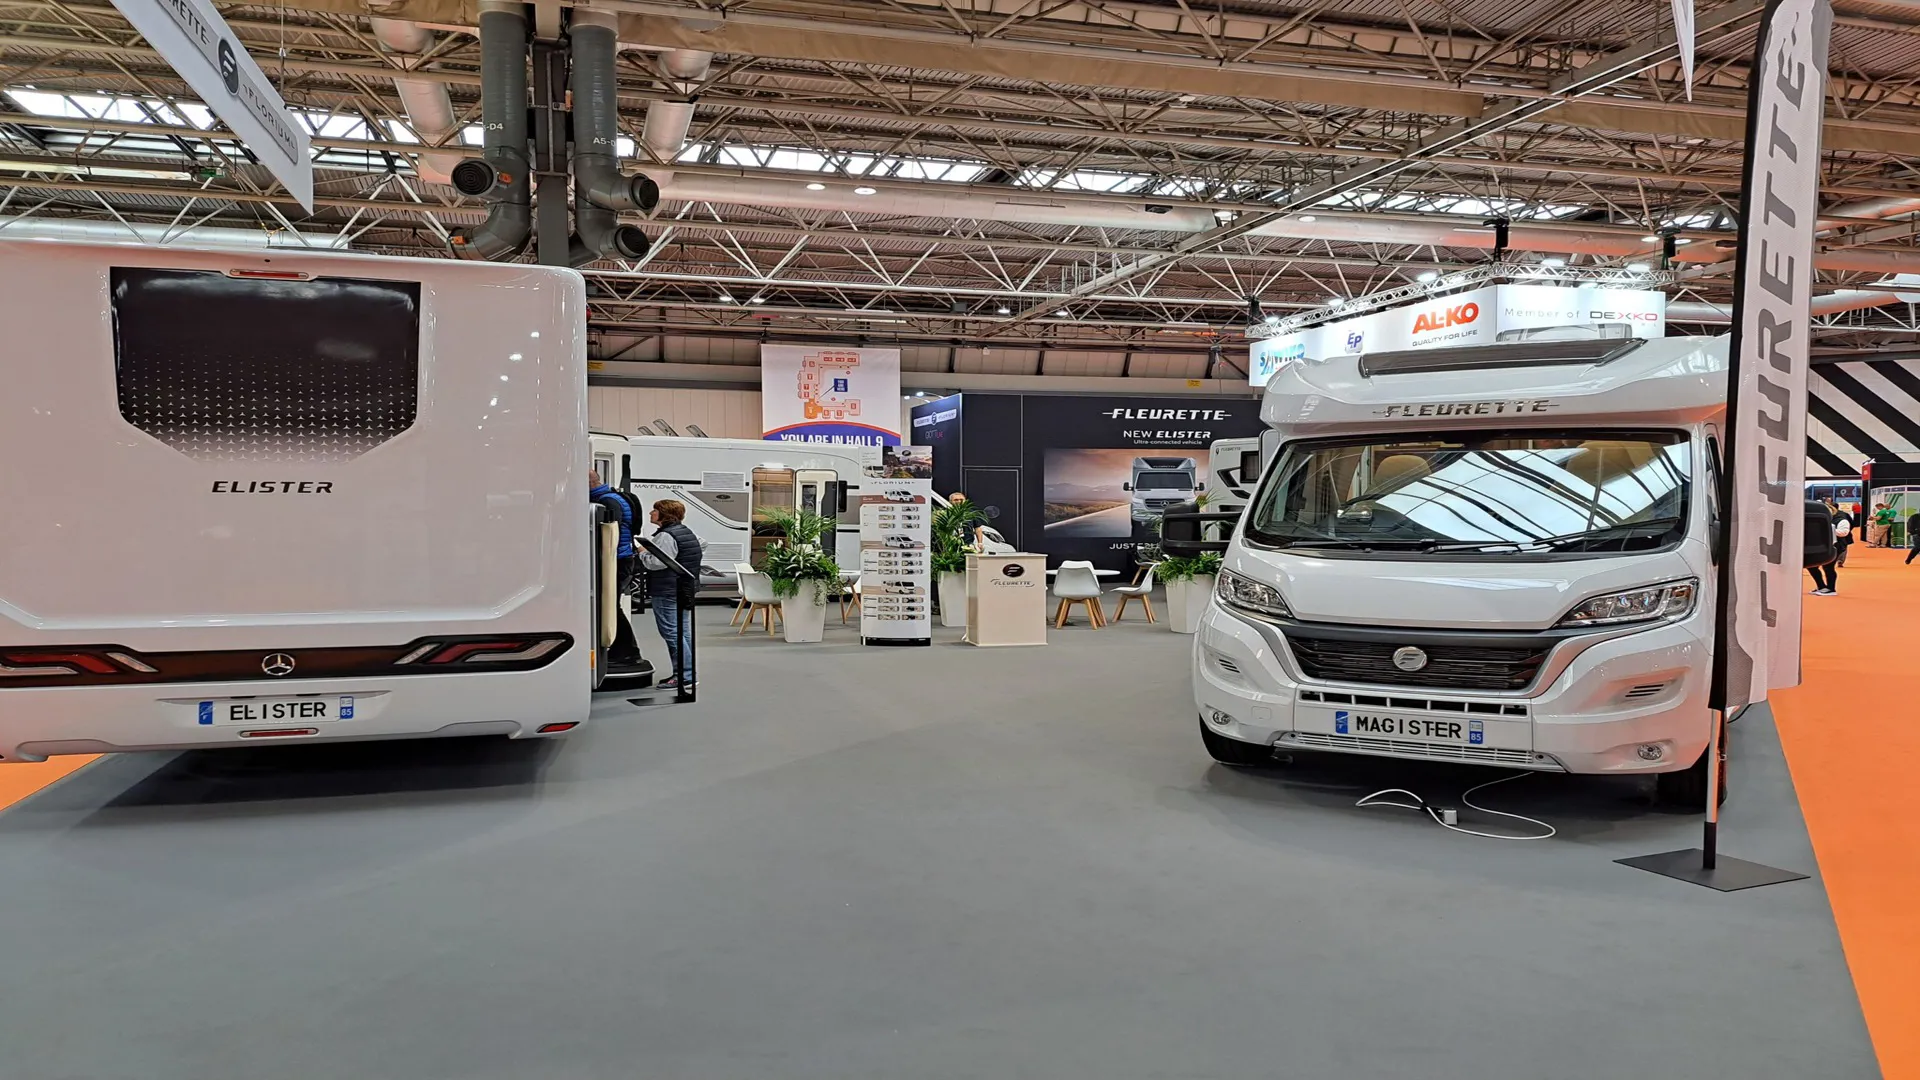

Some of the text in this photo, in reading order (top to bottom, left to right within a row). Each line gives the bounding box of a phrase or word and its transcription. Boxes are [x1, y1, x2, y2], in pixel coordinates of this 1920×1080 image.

[1412, 302, 1479, 335] AL-KO
[1504, 307, 1580, 319] Member of
[1412, 329, 1479, 347] QUALITY FOR LIFE
[1108, 408, 1229, 420] FLEURETTE
[1384, 399, 1552, 418] FLEURETTE
[781, 433, 804, 442] YOU
[831, 435, 844, 444] IN
[846, 436, 872, 446] HALL
[1123, 430, 1212, 439] NEW ELISTER
[211, 480, 334, 494] ELISTER
[229, 702, 353, 721] ELISTER 85
[1356, 715, 1462, 739] MAGISTER
[1470, 733, 1482, 741] 85
